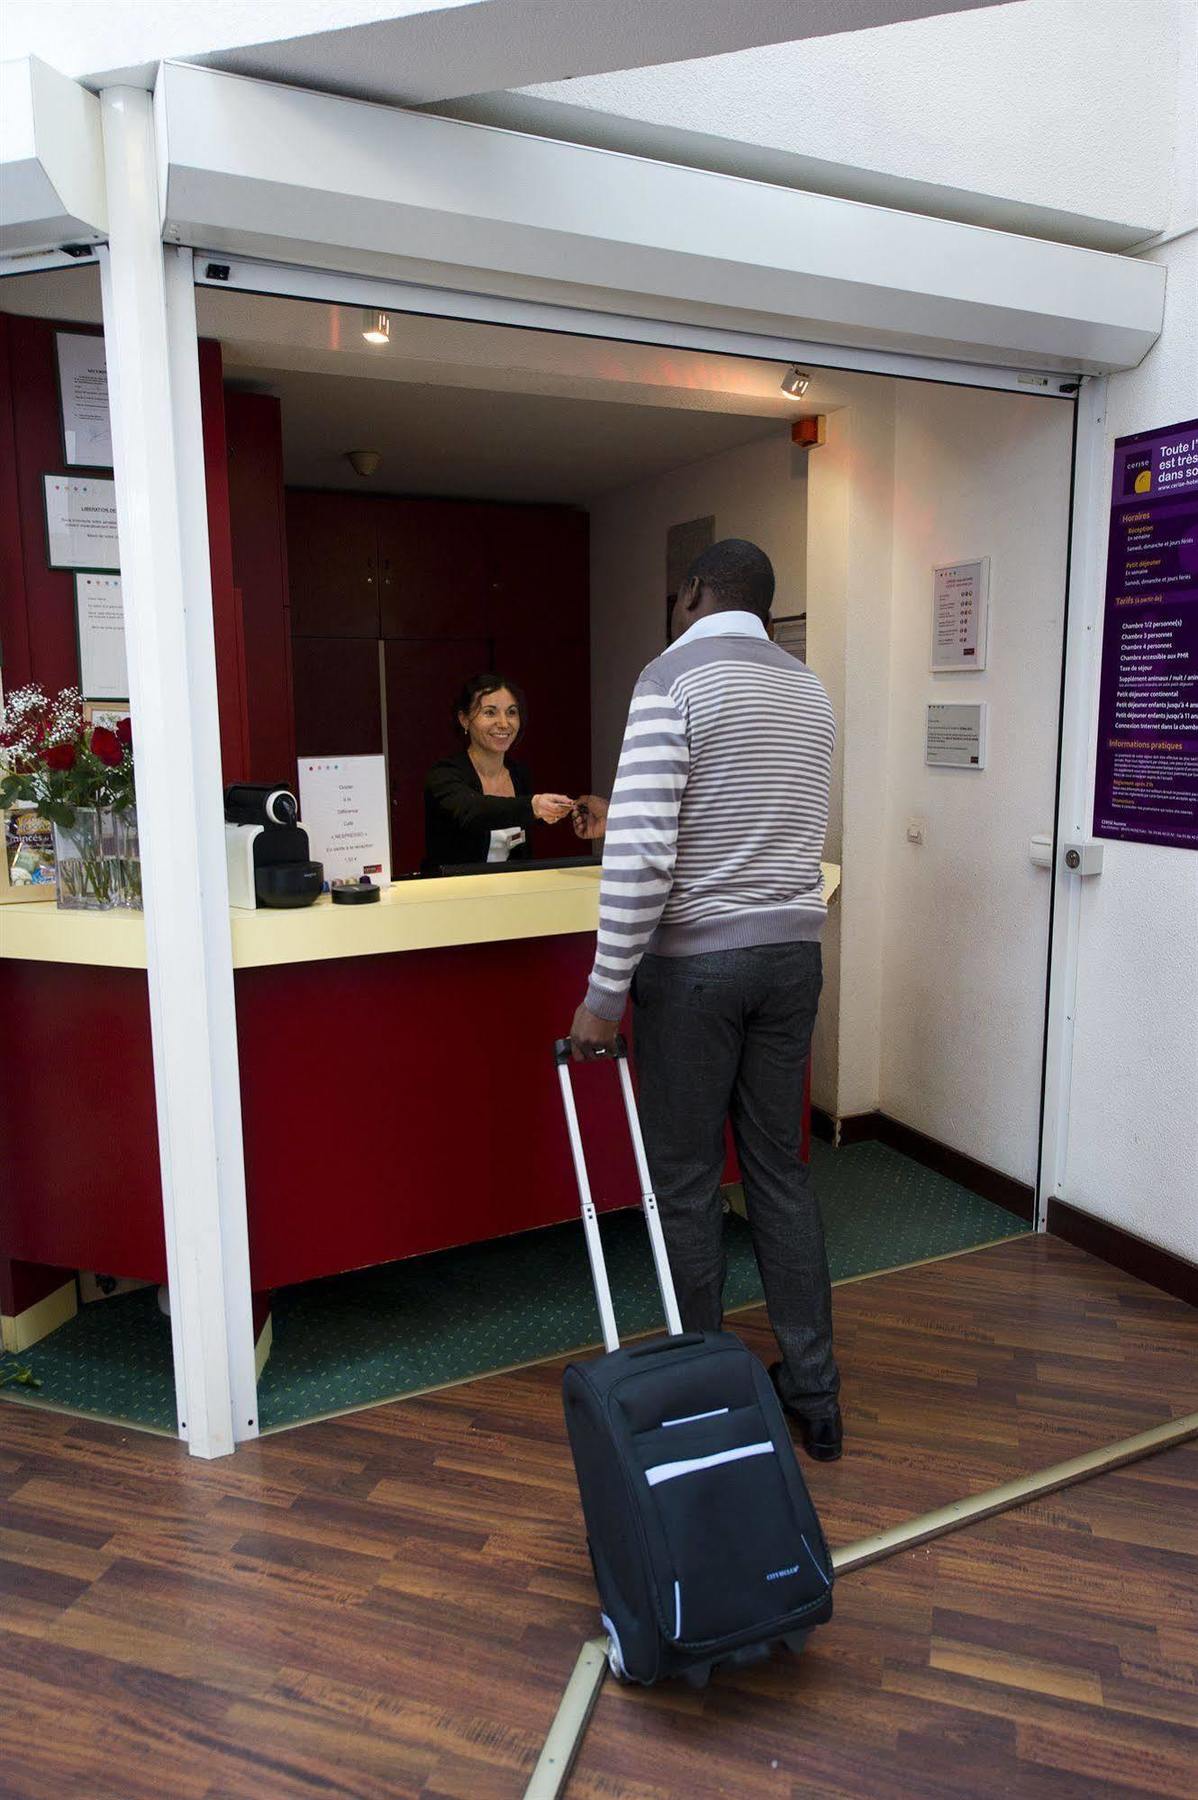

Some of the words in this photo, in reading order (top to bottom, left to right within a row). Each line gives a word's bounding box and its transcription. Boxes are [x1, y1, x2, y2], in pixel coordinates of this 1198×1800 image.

[1160, 442, 1189, 457] Toute
[1126, 460, 1150, 470] cerise
[1159, 456, 1176, 470] est
[1177, 453, 1198, 467] très
[1158, 470, 1184, 483] dans
[1122, 512, 1151, 523] Horaires
[1115, 595, 1134, 605] Tarifs
[1120, 653, 1141, 661] Chambre
[1138, 664, 1153, 672] séjour
[1129, 691, 1149, 699] déjeuner
[1128, 701, 1147, 709] déjeuner
[1127, 712, 1147, 720] déjeuner
[1109, 739, 1150, 749] Informations
[1150, 741, 1183, 751] pratiques
